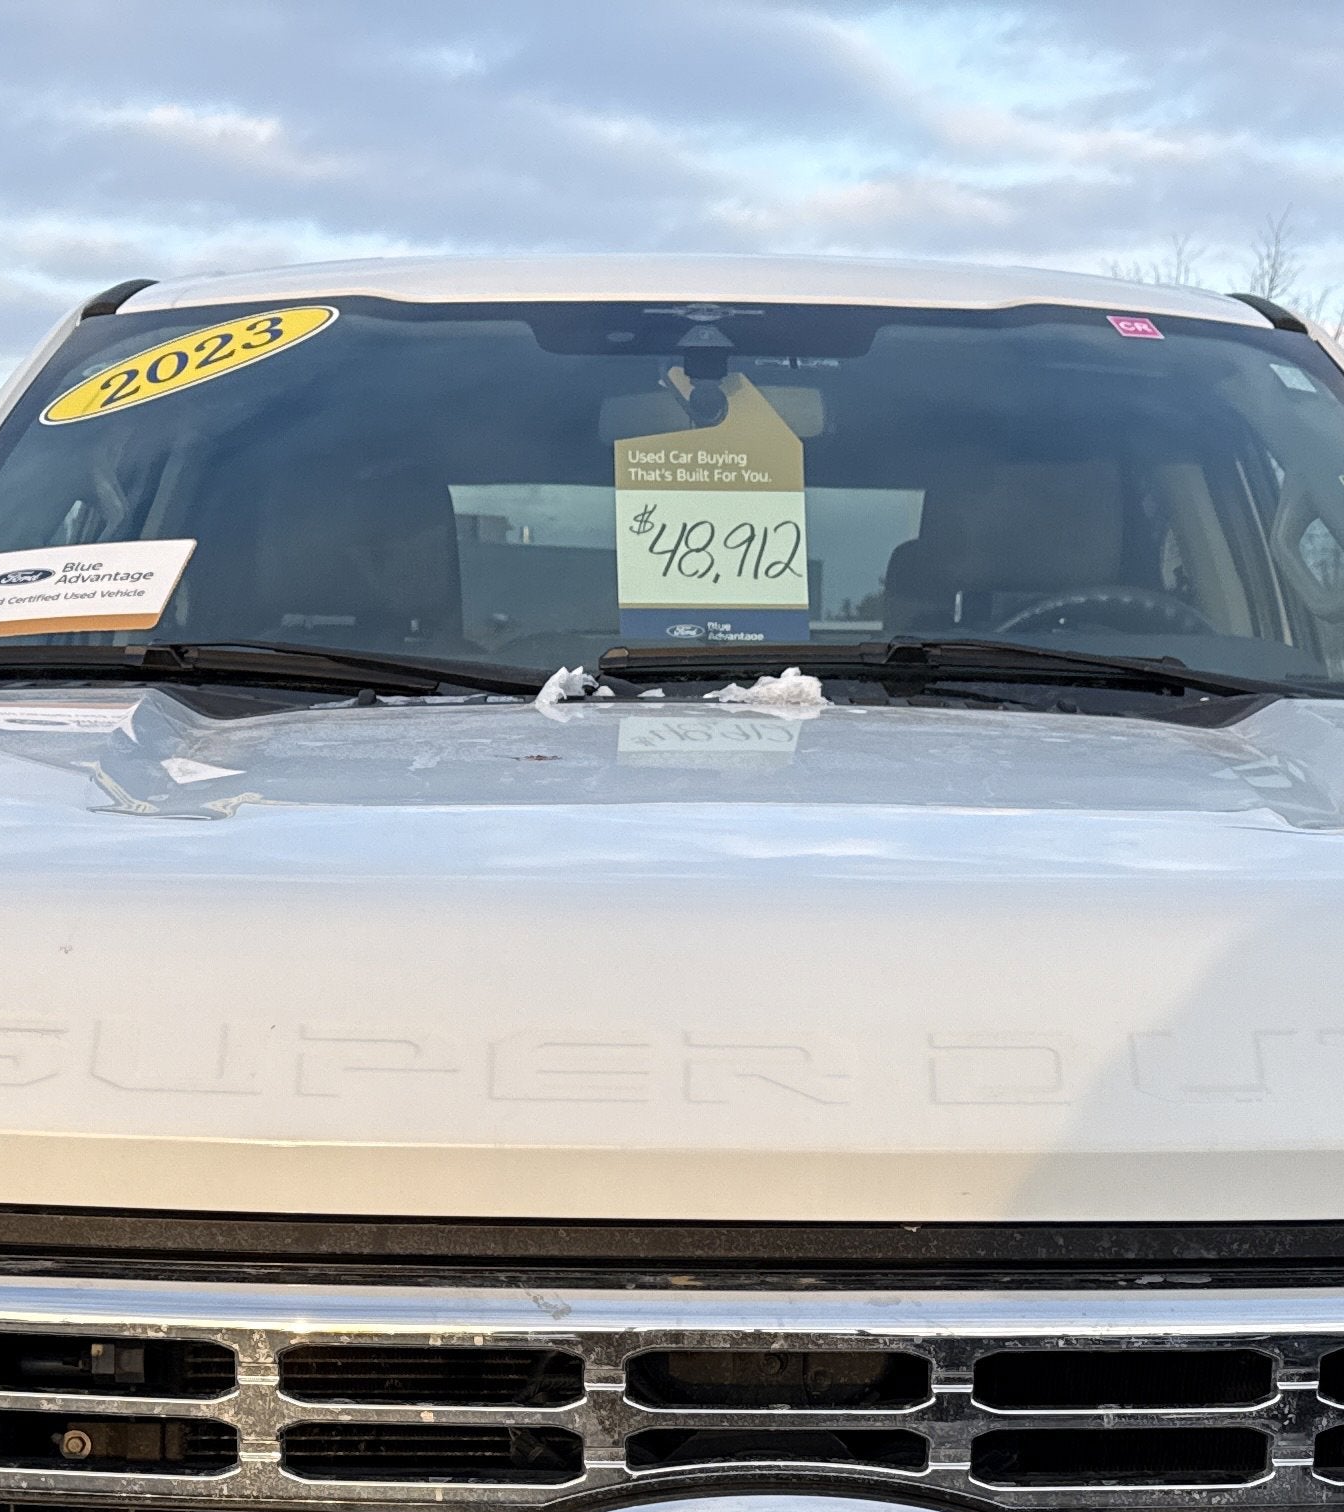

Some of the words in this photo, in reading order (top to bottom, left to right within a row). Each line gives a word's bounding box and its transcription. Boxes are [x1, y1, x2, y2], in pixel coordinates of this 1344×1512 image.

[1119, 321, 1153, 333] CR
[99, 316, 284, 409] 2023
[627, 450, 665, 464] Used
[669, 450, 693, 464] Car
[697, 450, 748, 468] Buying
[628, 468, 673, 482] That's
[676, 468, 710, 482] Built
[714, 469, 737, 482] For
[741, 469, 772, 483] You.
[629, 503, 803, 584] $48,912
[61, 561, 104, 573] Blue
[0, 569, 44, 585] Ford
[54, 570, 155, 586] Advantage
[7, 592, 61, 606] Certified
[63, 591, 96, 601] Used
[100, 588, 147, 599] Vehicle
